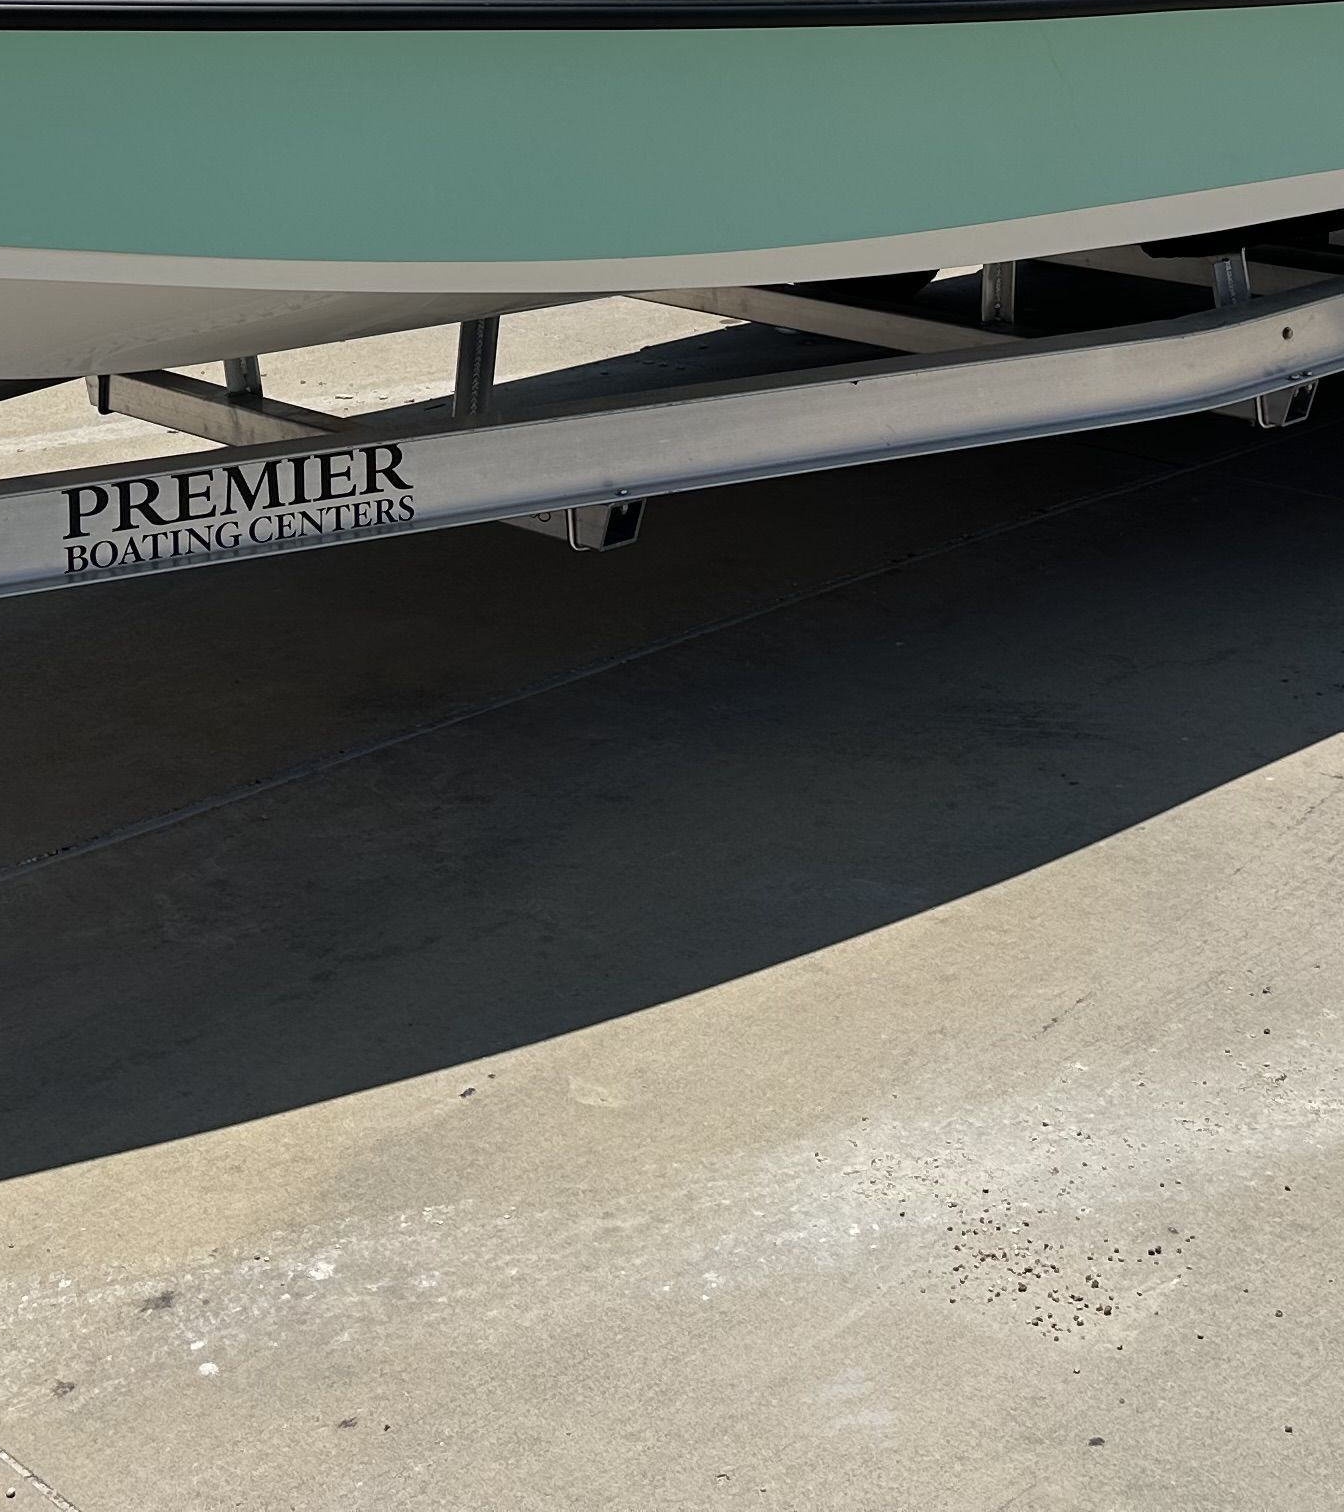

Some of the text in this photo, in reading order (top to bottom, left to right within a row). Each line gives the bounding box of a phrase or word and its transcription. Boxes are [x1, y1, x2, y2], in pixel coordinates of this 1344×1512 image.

[62, 443, 414, 540] PREMIER
[64, 495, 416, 574] BOATING CENTERS
